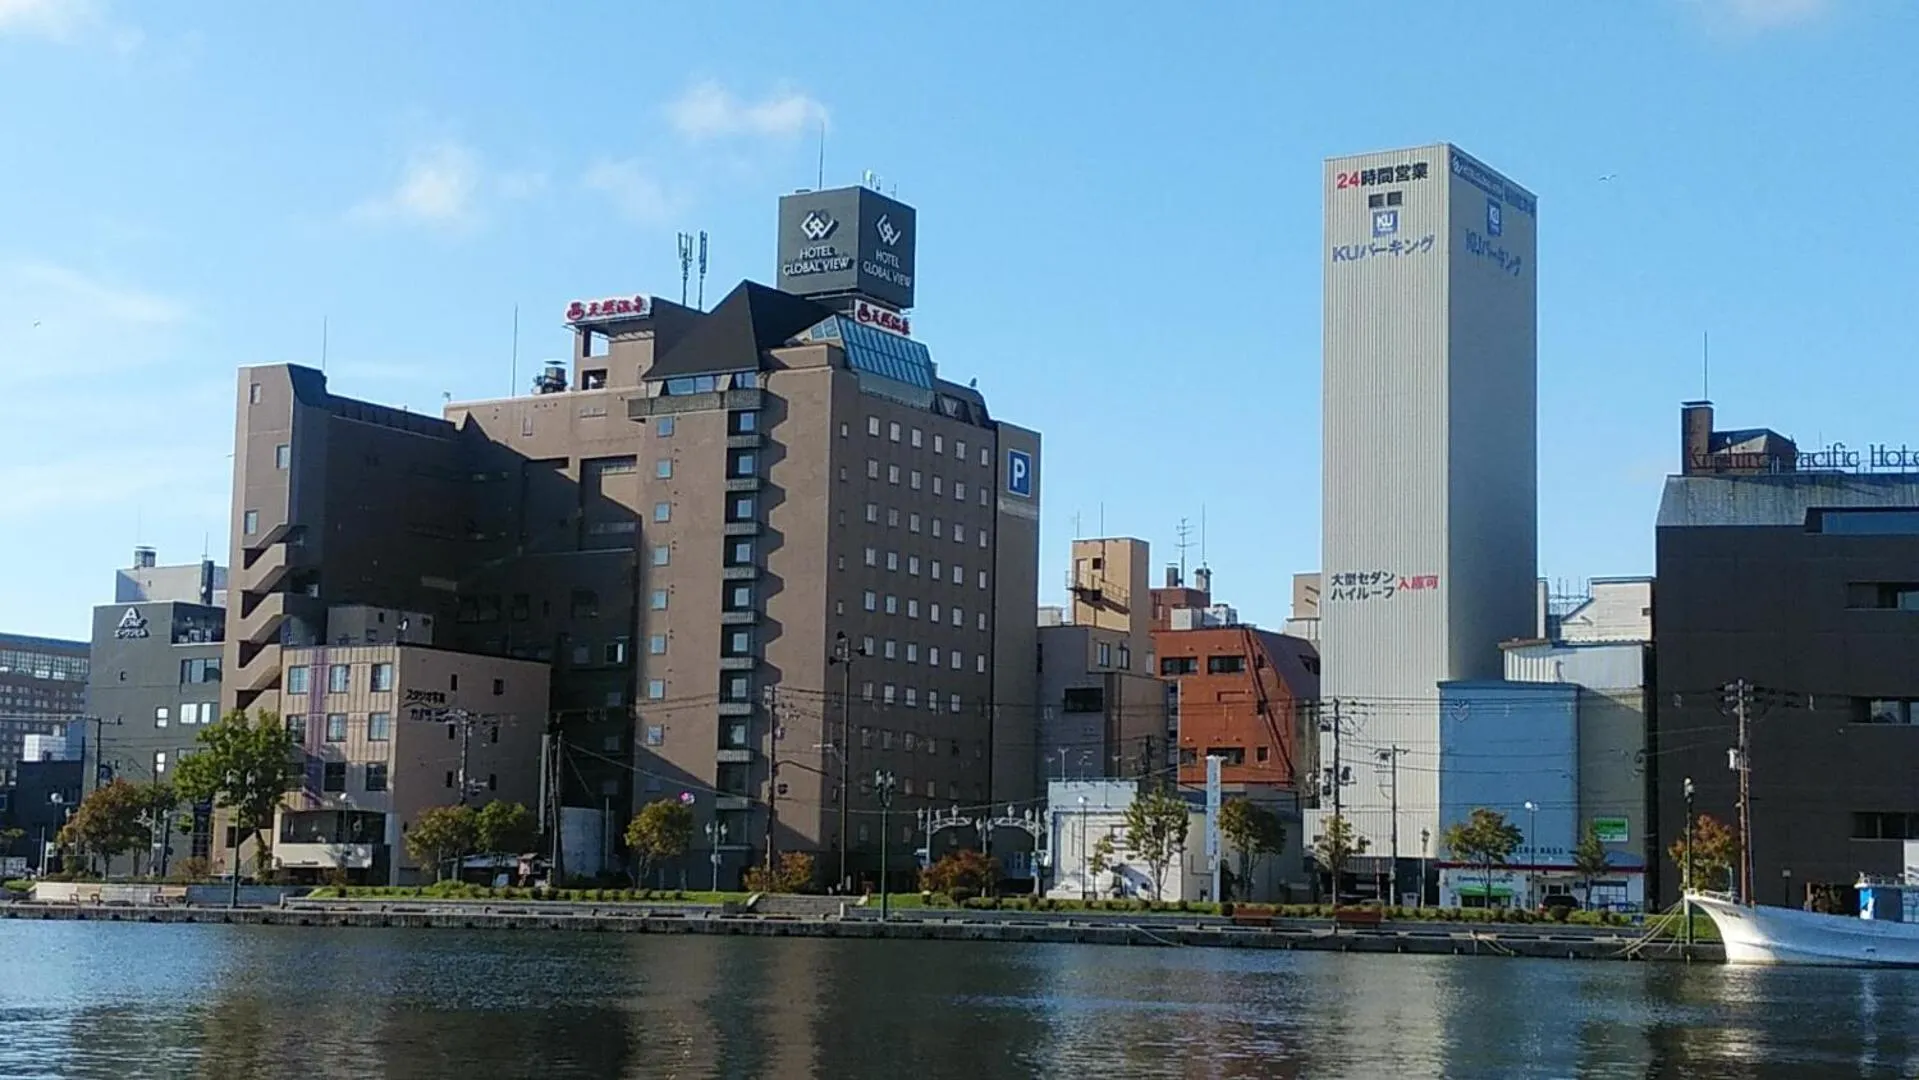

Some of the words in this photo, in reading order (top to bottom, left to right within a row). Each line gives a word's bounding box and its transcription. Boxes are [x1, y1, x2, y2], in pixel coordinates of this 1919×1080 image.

[1337, 161, 1429, 189] 24時間営業
[1376, 213, 1394, 227] KU
[800, 245, 833, 259] HOTEL
[875, 248, 900, 269] HOTEL
[1332, 235, 1435, 263] KUパーキング
[783, 258, 822, 276] GLOBAL
[822, 256, 850, 271] VIEW
[863, 260, 891, 282] GLOBAL
[890, 271, 912, 288] VIEW
[1013, 457, 1026, 488] P
[1331, 586, 1395, 600] ハイルーフ
